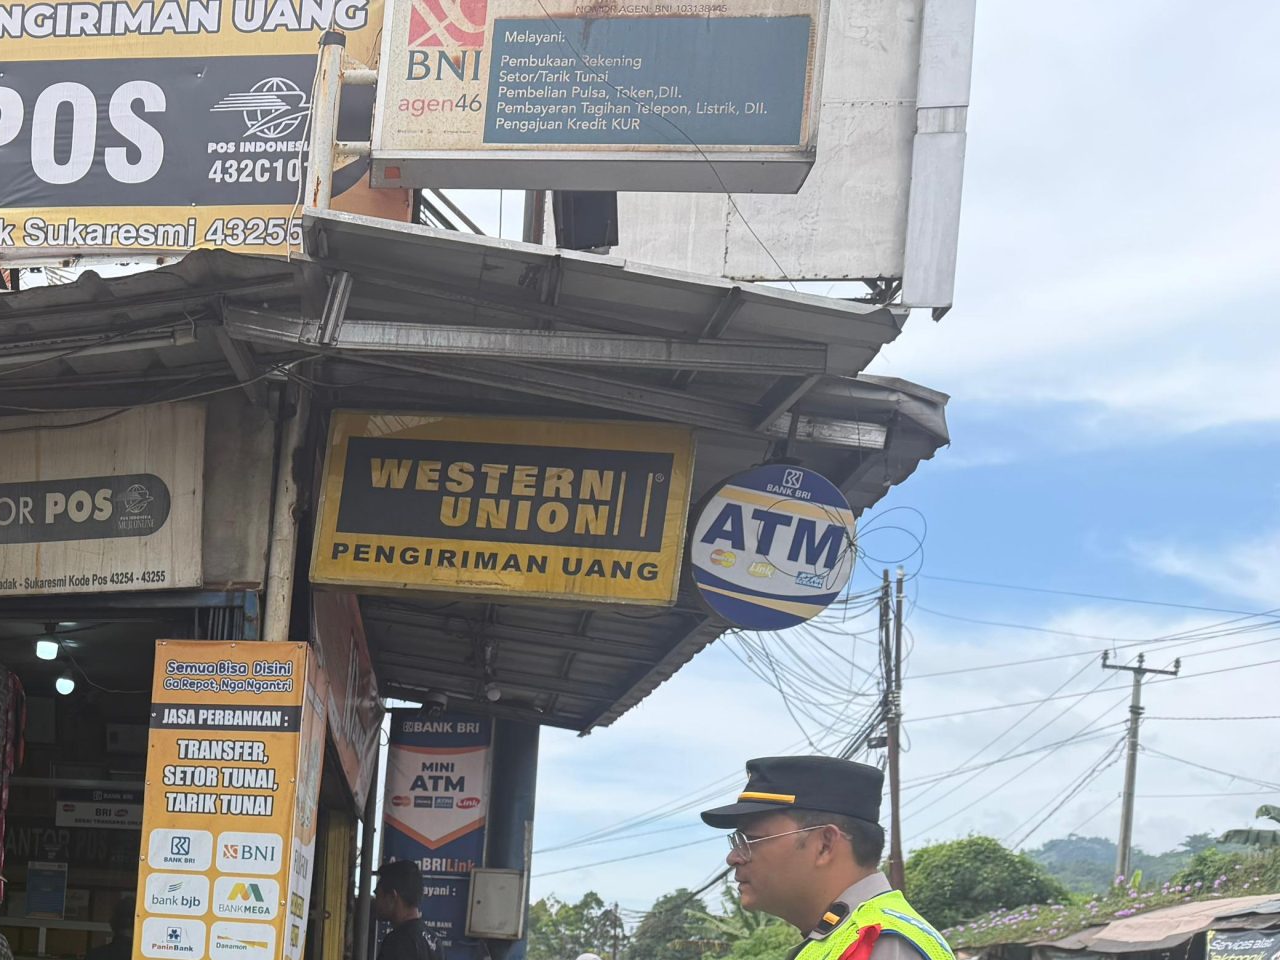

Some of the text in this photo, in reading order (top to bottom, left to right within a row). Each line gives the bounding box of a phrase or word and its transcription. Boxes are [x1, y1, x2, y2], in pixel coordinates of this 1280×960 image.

[233, 0, 367, 31] UANG
[619, 4, 652, 15] AGEN:
[654, 4, 673, 14] BNI
[505, 31, 566, 44] Melayani:
[406, 50, 482, 82] BNI
[501, 55, 642, 70] Pembukaan Rekening
[499, 70, 609, 84] Setor/Tarik Tunai
[498, 86, 568, 99] Pembelian
[572, 86, 609, 100] Pulsa,
[398, 93, 483, 117] agen46
[496, 102, 767, 117] Pembayaran Tagihan Telepon, Listrik, Dll.
[495, 117, 563, 133] Pengajuan
[567, 117, 608, 130] Kredit
[612, 117, 640, 130] KUR
[208, 140, 311, 154] POS INDONESI
[23, 215, 197, 248] Sukaresmi
[205, 217, 303, 246] 43255
[370, 458, 614, 501] WESTERN
[767, 483, 812, 499] BANK BRI
[45, 488, 113, 525] POS
[439, 495, 614, 536] UNION
[700, 503, 847, 569] ATM
[332, 541, 660, 582] PENGIRIMAN UANG
[24, 574, 67, 589] Sukaresmi
[69, 573, 90, 588] Kode
[92, 574, 108, 586] Pos
[110, 572, 134, 585] 43254
[141, 570, 166, 583] 43255
[166, 661, 293, 677] Semua Bisa Disini
[163, 678, 293, 692] Ga Repot, Nga Ngantri
[162, 709, 281, 726] JASA PERBANKAN
[413, 721, 480, 734] BANK BRI
[177, 739, 269, 764] TRANSFER,
[421, 761, 455, 773] MINI
[163, 766, 279, 791] SETOR TUNAI,
[409, 775, 466, 793] ATM
[96, 807, 112, 817] BRI
[166, 793, 274, 816] TARIK TUNAI
[241, 845, 275, 861] BNI
[152, 895, 201, 908] bank bjb
[152, 943, 194, 952] PaninBank
[216, 942, 247, 951] Danamon
